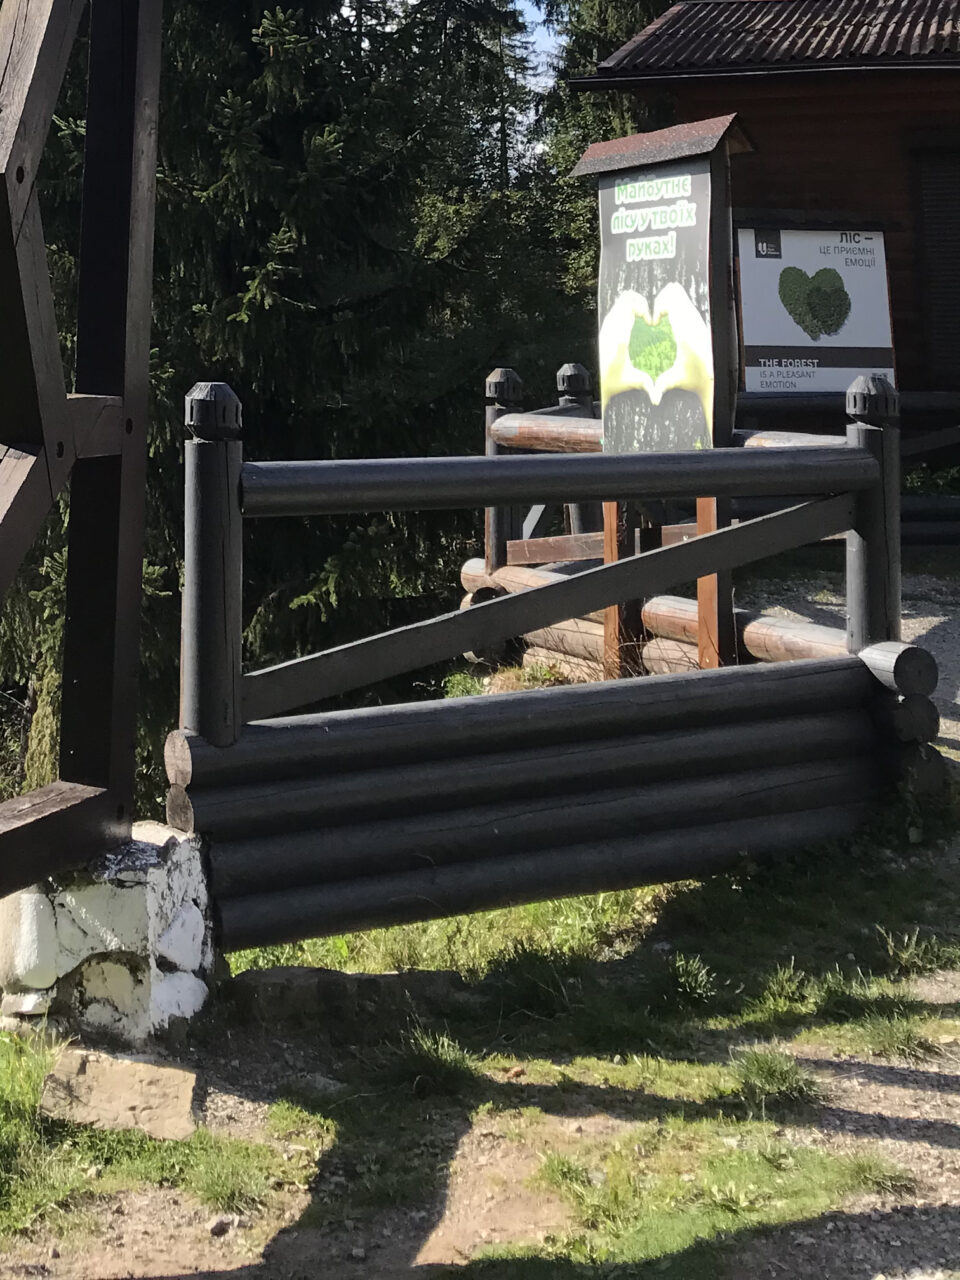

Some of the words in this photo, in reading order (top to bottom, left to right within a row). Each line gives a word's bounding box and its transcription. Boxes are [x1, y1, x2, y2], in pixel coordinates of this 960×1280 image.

[839, 232, 861, 244] ЛІС
[628, 234, 675, 258] руках!
[819, 246, 831, 256] ЦЕ
[833, 246, 875, 256] ПРИЄМНІ
[844, 257, 876, 268] ЕМОЦІЇ
[759, 359, 780, 368] THE
[781, 359, 819, 368] FOREST
[776, 371, 816, 379] PLEASANT
[760, 381, 797, 389] EMOTION
